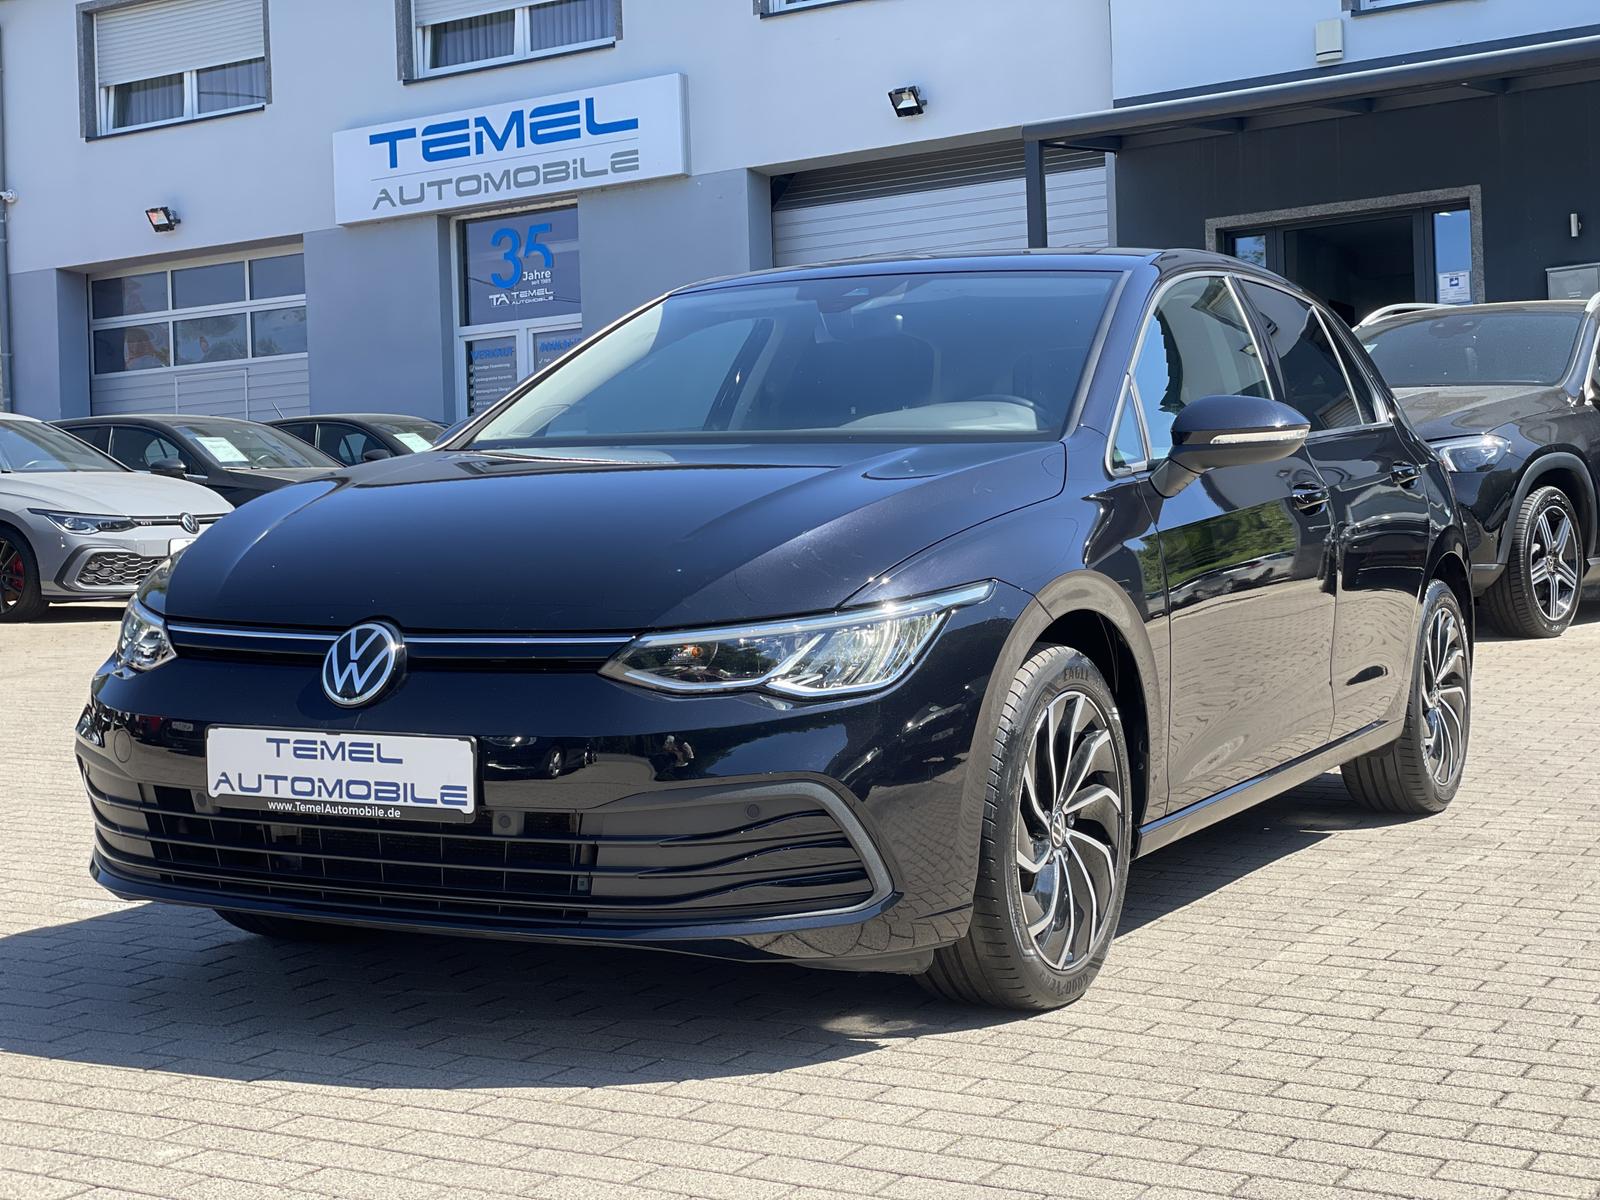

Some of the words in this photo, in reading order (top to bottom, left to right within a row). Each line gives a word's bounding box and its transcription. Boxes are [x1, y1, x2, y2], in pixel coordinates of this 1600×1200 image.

[369, 97, 639, 169] TEMEL
[490, 223, 554, 289] 35
[522, 269, 552, 281] Jahre
[511, 288, 554, 299] TEMEL
[266, 737, 403, 764] TEMEL
[213, 771, 467, 806] AUTOMOBILE
[267, 800, 401, 818] www.TemelAutomobile.de
